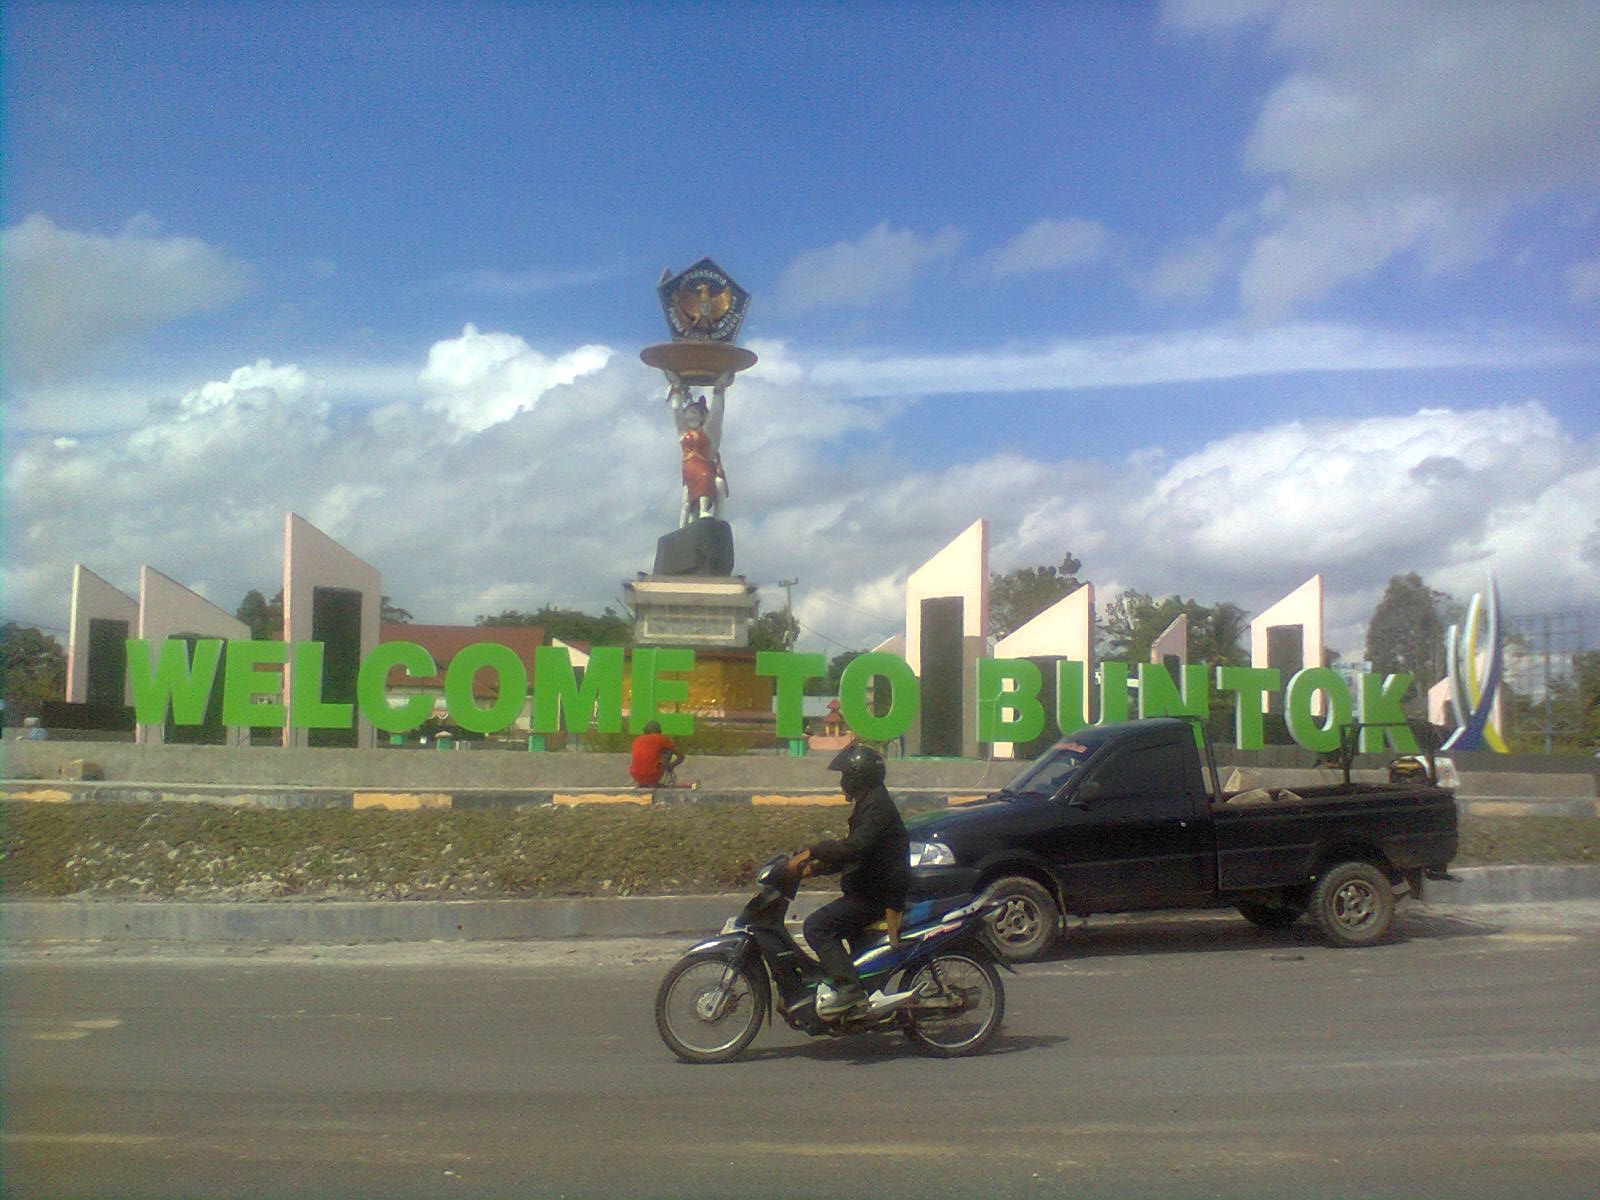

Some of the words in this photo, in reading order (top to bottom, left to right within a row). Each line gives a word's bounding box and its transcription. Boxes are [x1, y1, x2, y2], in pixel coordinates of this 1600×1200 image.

[124, 639, 696, 737] WELCOME
[756, 649, 921, 741] TO
[976, 657, 1418, 754] BUNTOK
